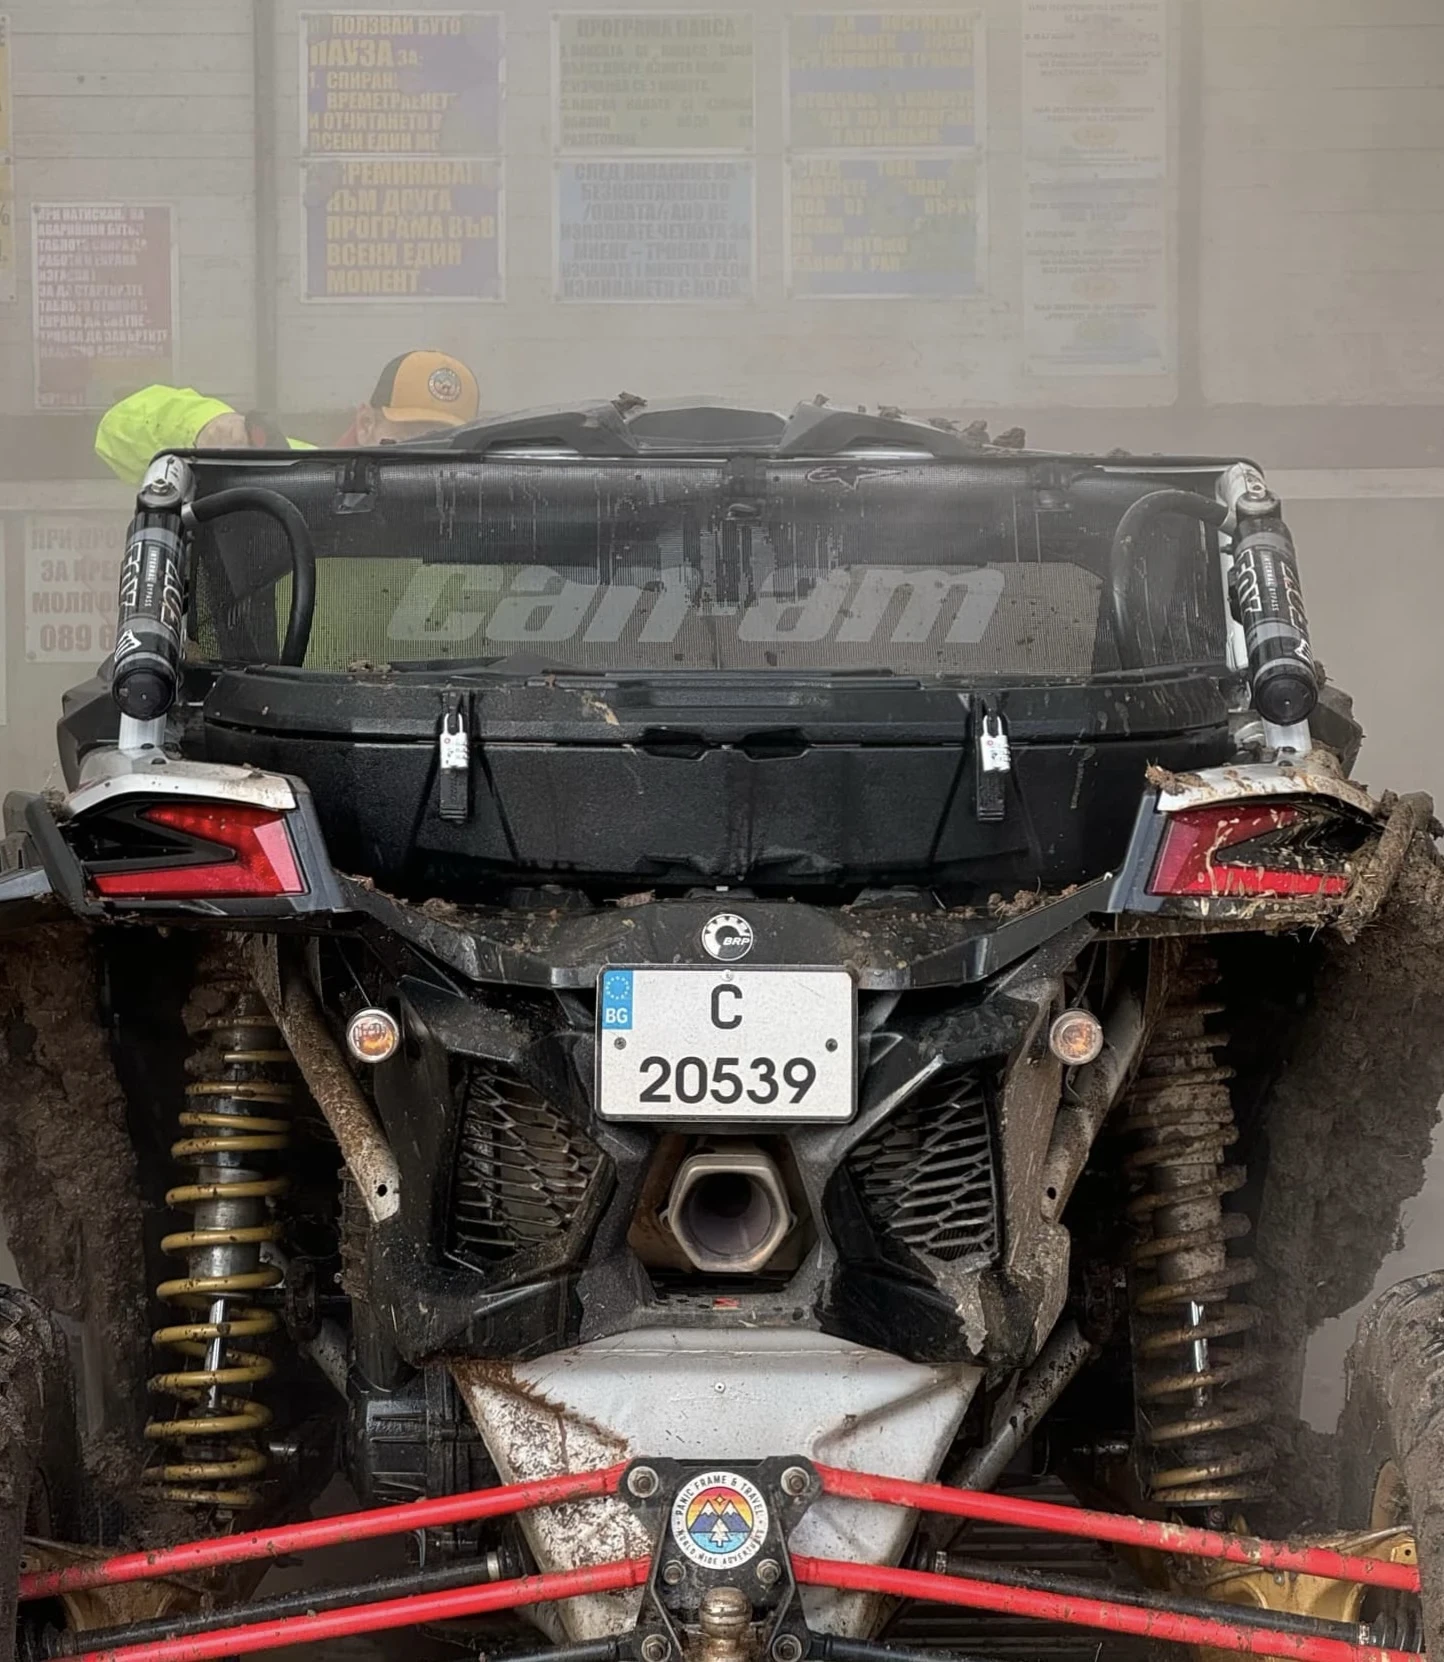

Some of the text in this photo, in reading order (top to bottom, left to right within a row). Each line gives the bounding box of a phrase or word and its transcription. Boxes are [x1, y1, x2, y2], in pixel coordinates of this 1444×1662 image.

[418, 16, 462, 34] БУТО
[309, 39, 394, 67] ПАУЗА
[327, 71, 400, 90] СПИРАН
[327, 91, 458, 111] ВРЕМЕТРАЕНЕТ
[326, 216, 496, 240] ПРОГРАМА ВЪВ
[403, 243, 463, 269] ЕДИН
[326, 269, 421, 294] МОМЕНТ
[32, 528, 72, 550] ПРИ
[41, 560, 68, 582] ЗА
[32, 591, 94, 614] МОЛЯ
[40, 623, 93, 652] 089
[723, 936, 751, 946] BRP
[605, 1008, 628, 1024] BG
[711, 983, 743, 1030] C
[639, 1055, 817, 1105] 20539
[675, 1475, 763, 1516] PANIC FRAME & TRAVEL
